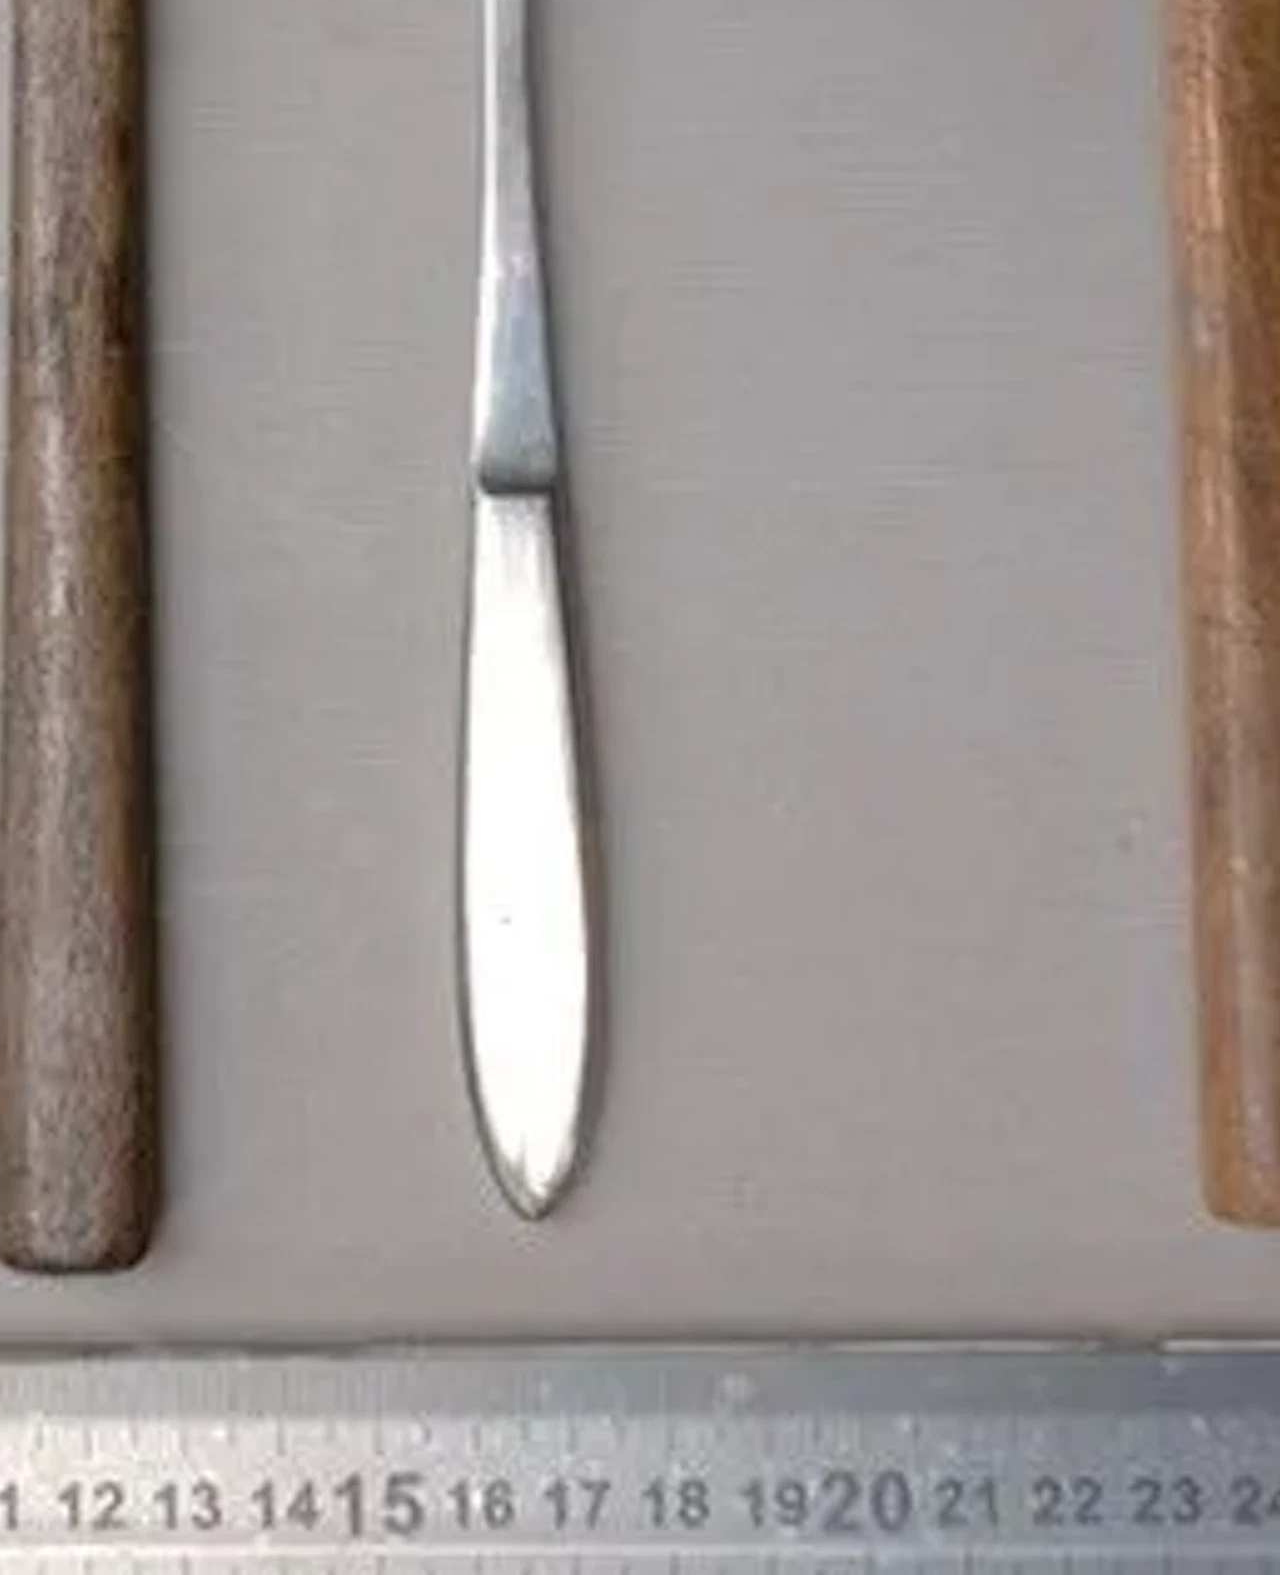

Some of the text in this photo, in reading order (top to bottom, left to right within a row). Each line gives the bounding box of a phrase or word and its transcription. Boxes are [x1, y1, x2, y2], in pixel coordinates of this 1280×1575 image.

[58, 1482, 128, 1534] 12
[154, 1480, 223, 1531] 13
[252, 1480, 320, 1530] 14
[335, 1472, 425, 1538] 15
[449, 1478, 515, 1530] 16
[545, 1479, 611, 1530] 17
[643, 1478, 710, 1529] 18
[741, 1478, 809, 1529] 19
[823, 1470, 912, 1534] 20
[936, 1476, 999, 1528] 21
[1033, 1475, 1103, 1525] 22
[1130, 1476, 1203, 1524] 23
